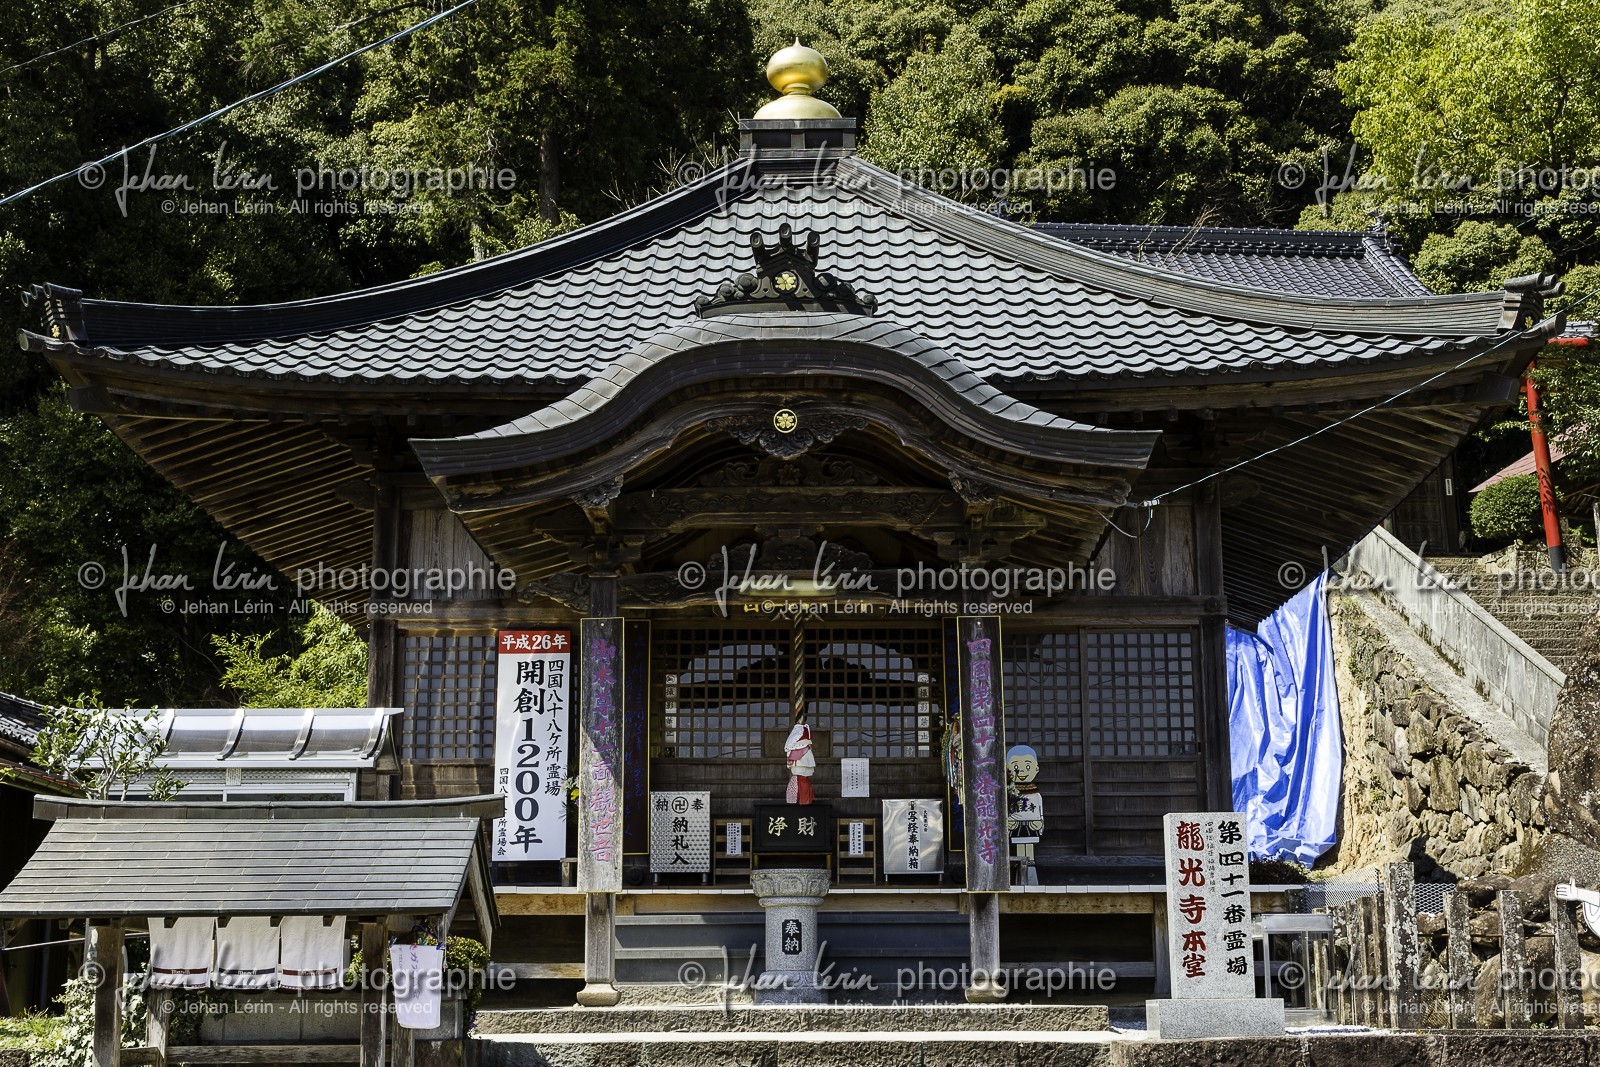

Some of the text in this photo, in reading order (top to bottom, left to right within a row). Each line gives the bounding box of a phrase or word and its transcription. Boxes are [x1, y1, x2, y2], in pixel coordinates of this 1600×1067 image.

[501, 633, 568, 651] 平成26年
[919, 687, 929, 740] 撮影禁止
[509, 659, 546, 854] 開創1200年
[497, 767, 509, 856] 四国八所霊場会
[768, 816, 817, 836] 浄財
[670, 817, 690, 865] 納札入
[907, 810, 919, 870] 写経奉納箱
[1175, 820, 1207, 978] 龍光寺本堂
[1217, 820, 1247, 976] 第四十一番霊場
[785, 920, 800, 952] 奉納
